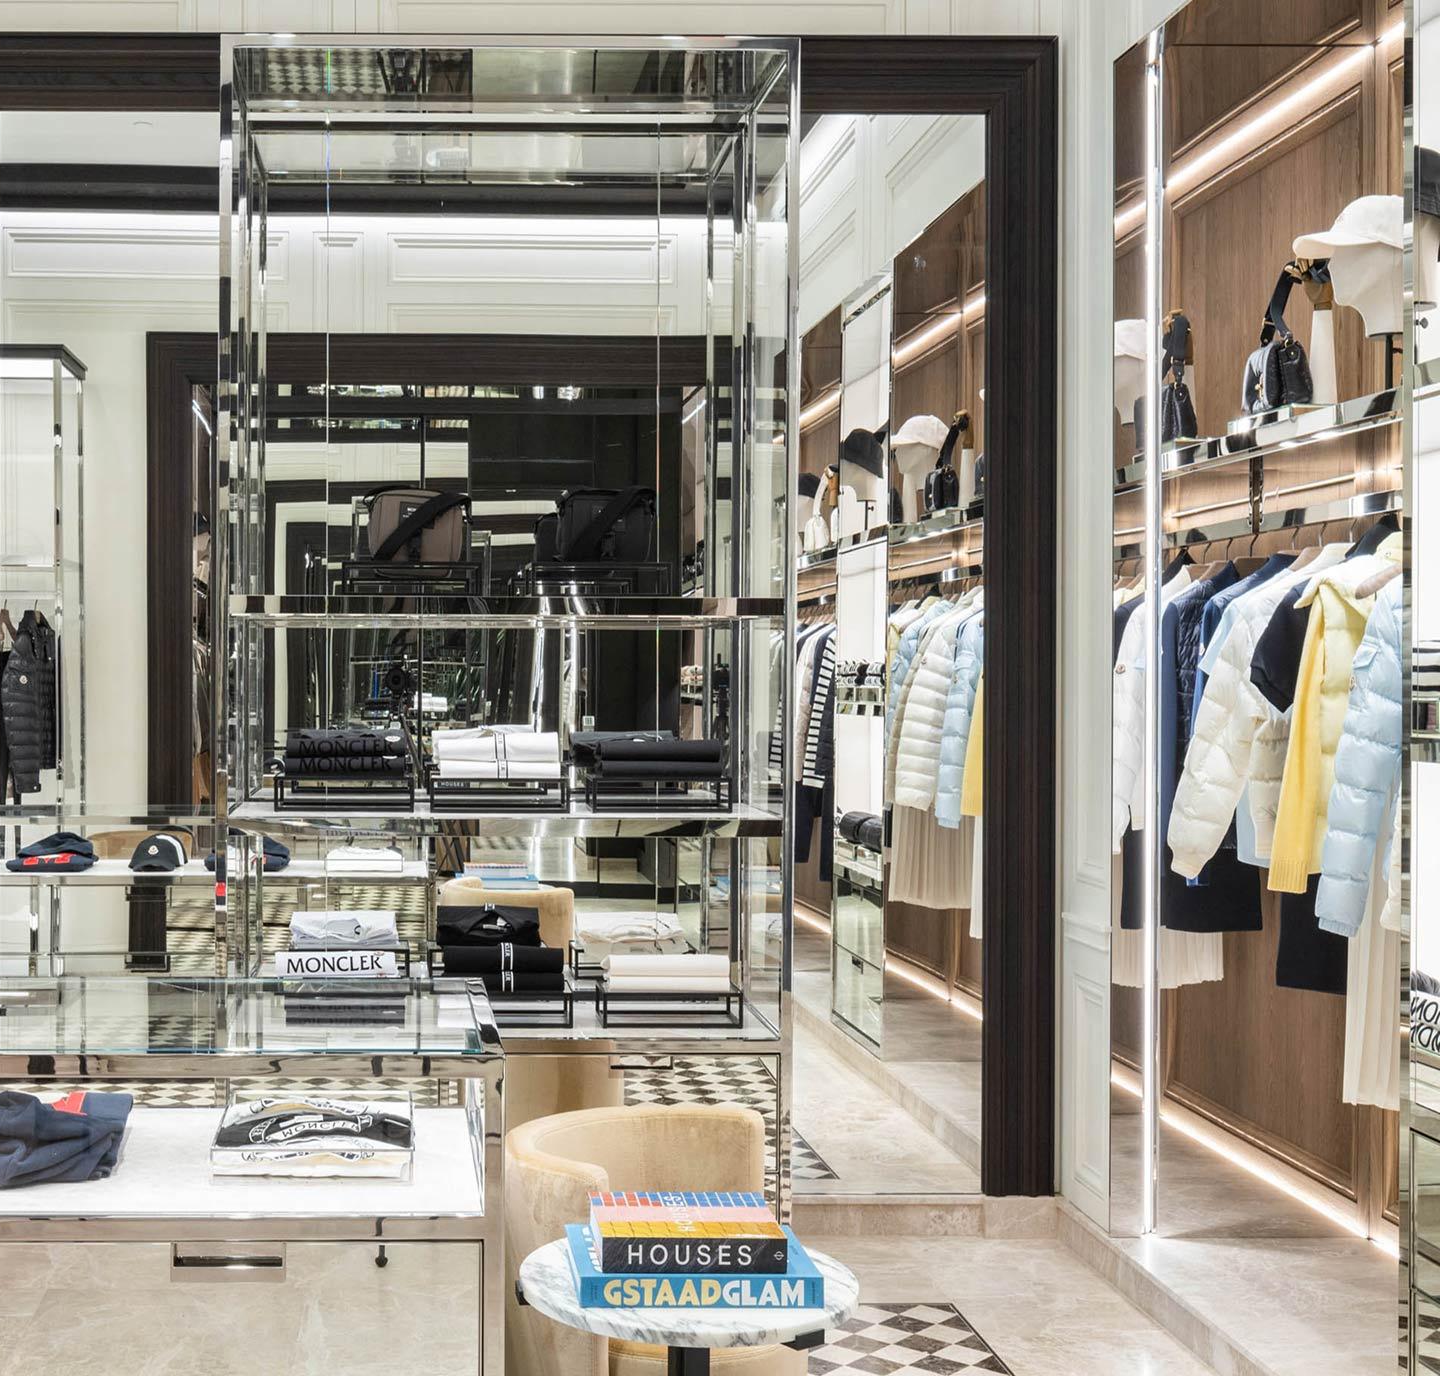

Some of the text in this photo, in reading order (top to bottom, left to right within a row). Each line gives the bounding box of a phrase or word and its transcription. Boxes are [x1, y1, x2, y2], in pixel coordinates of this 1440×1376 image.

[298, 739, 395, 755] MONCLER
[298, 757, 392, 772] MONCLER
[286, 956, 383, 974] MONCLER
[628, 1245, 752, 1266] HOUSES
[604, 1279, 805, 1307] GSTAADGLAM
